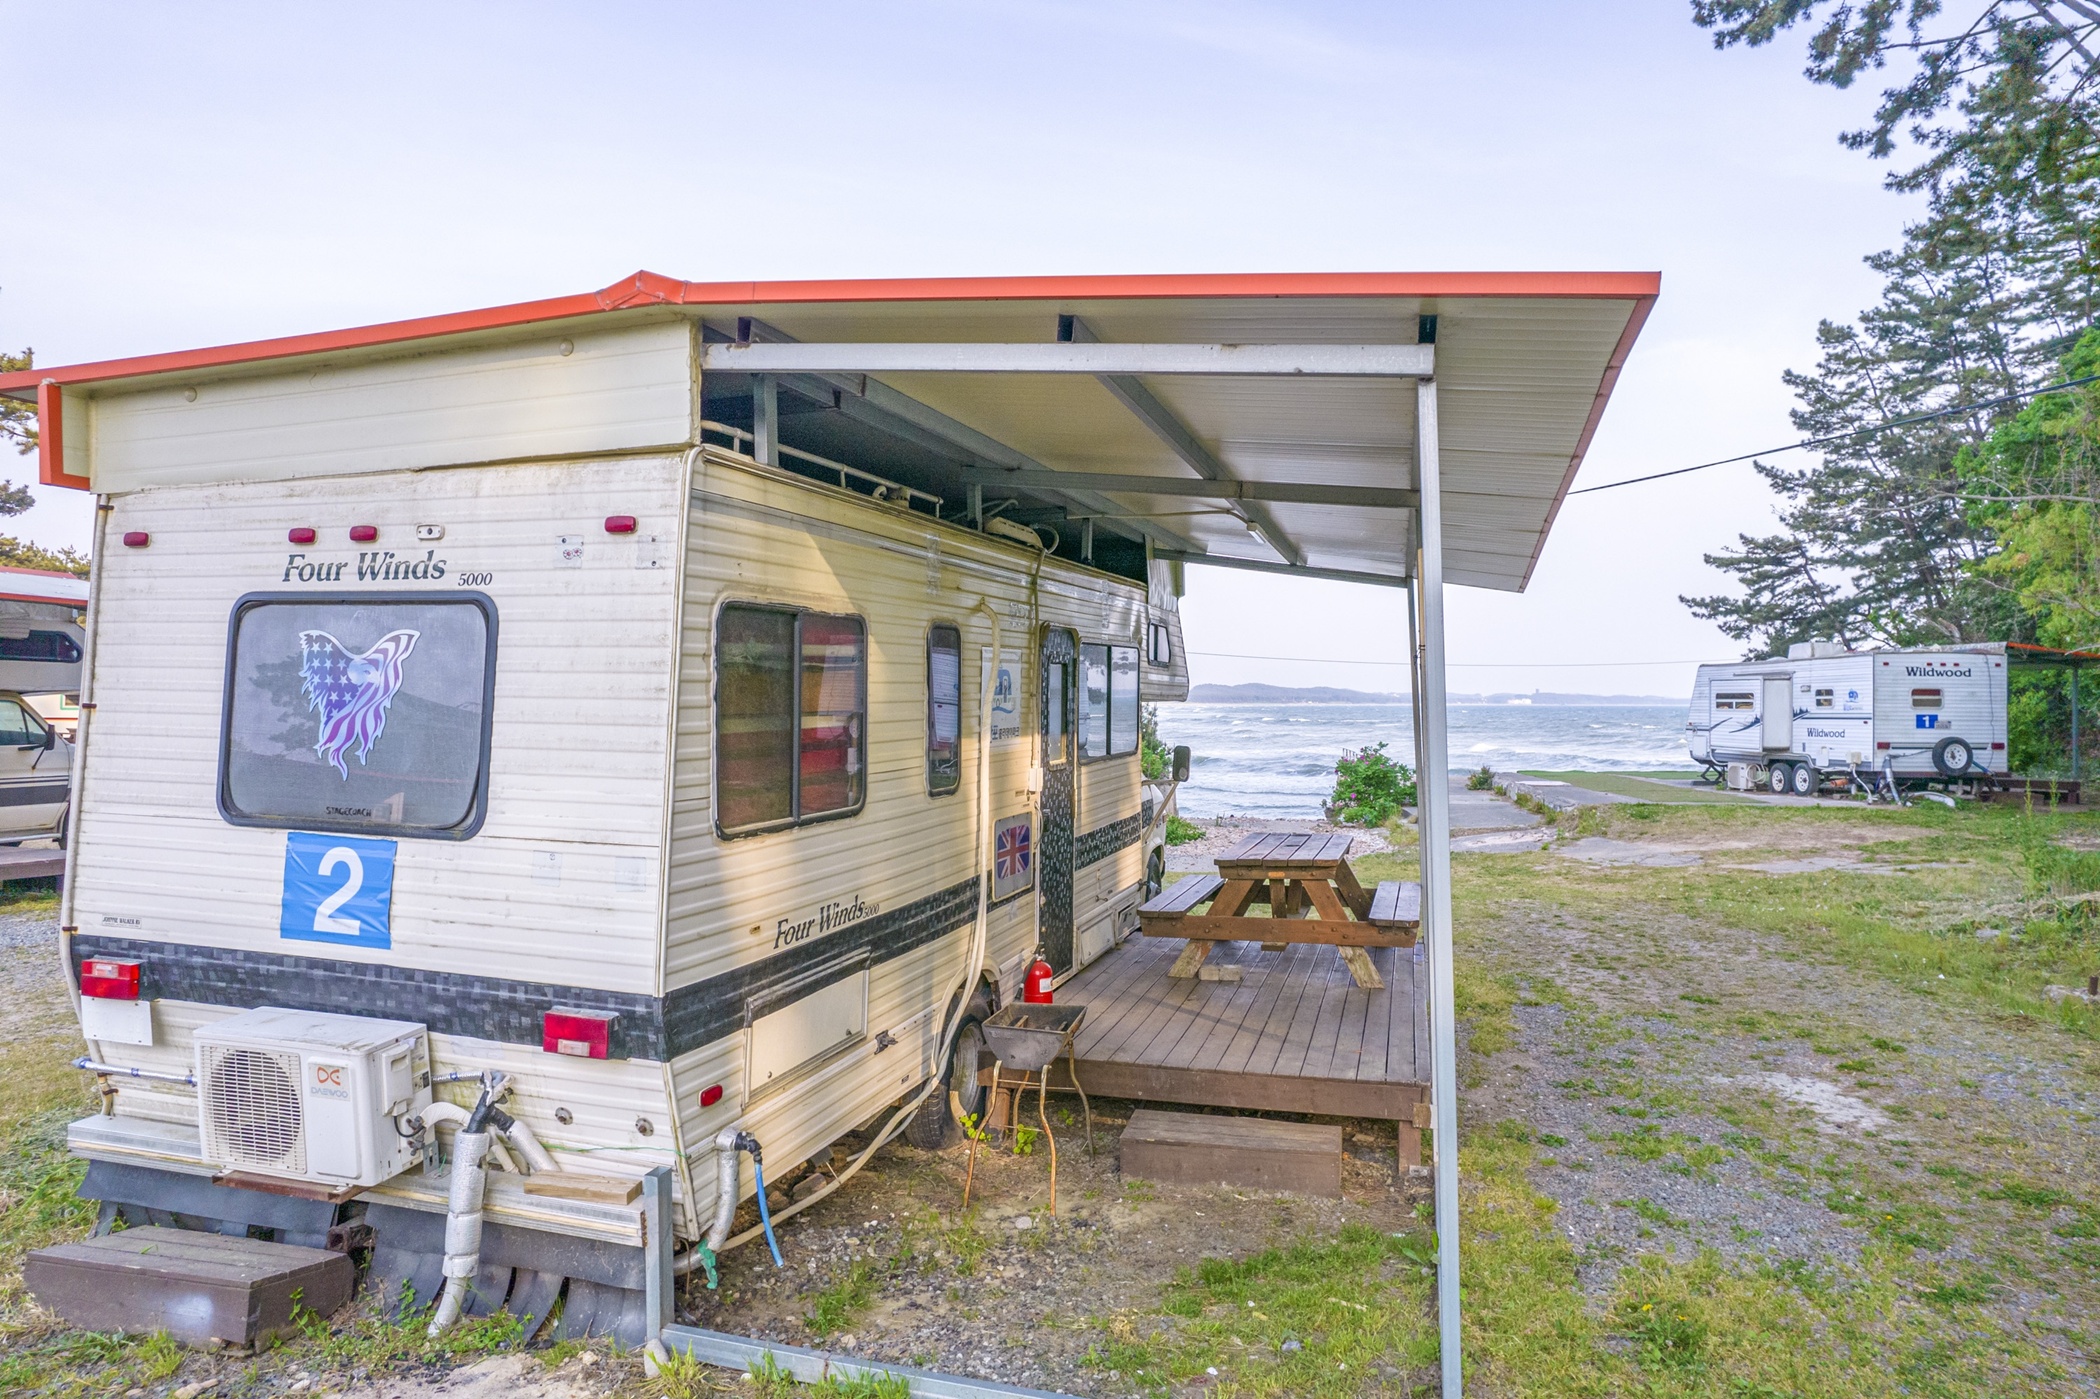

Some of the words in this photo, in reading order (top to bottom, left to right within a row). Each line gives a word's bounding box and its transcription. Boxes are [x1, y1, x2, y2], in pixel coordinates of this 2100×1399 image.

[282, 554, 348, 582] Four
[357, 550, 447, 581] Winds
[458, 572, 493, 586] 5000
[1906, 666, 1972, 677] Wildwood
[1922, 715, 1930, 728] 1
[1807, 728, 1845, 738] Wildwood
[326, 806, 372, 817] STAGECOACH
[313, 846, 364, 936] 2
[773, 918, 815, 950] Four
[820, 894, 865, 933] Winds
[863, 903, 880, 919] 5000
[311, 1086, 349, 1099] DAEWOO
